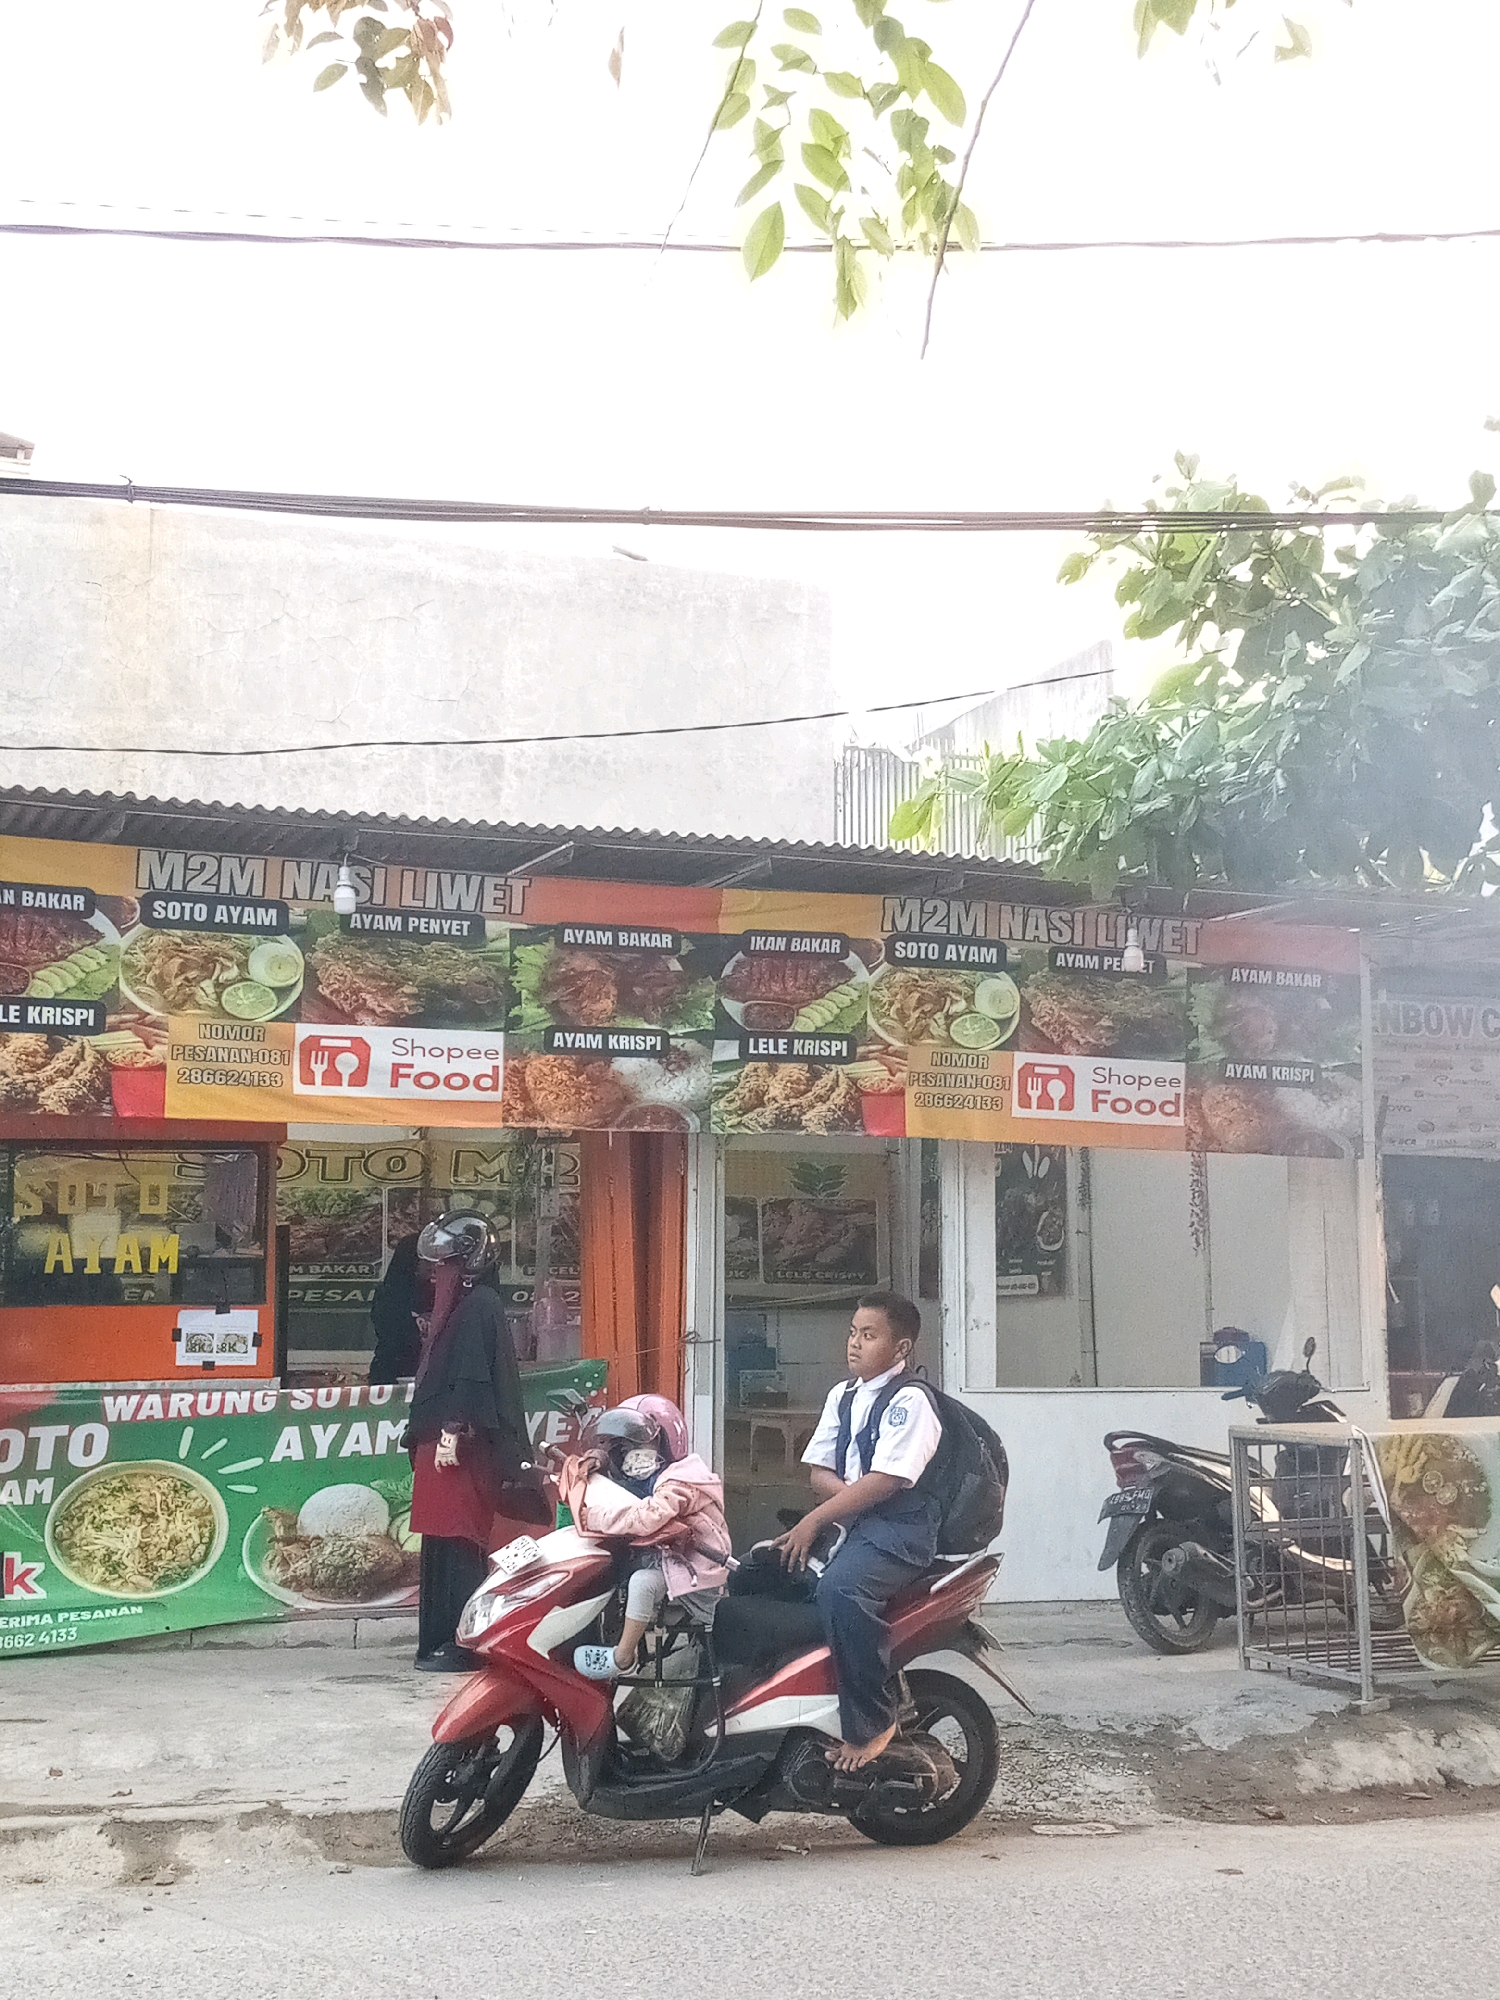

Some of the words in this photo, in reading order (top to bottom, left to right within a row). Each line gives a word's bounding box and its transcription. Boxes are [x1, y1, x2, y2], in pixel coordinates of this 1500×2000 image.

[136, 848, 267, 898] M2M
[280, 858, 388, 906] NASI
[400, 867, 532, 916] LIWET
[22, 889, 86, 912] BAKAR
[152, 900, 208, 923] SOTO
[214, 904, 278, 926] AYAM
[349, 913, 402, 932] AYAM
[408, 916, 471, 937] PENYET
[881, 896, 988, 938] M2M
[999, 903, 1084, 946] NASI
[1096, 912, 1202, 955] LIWET
[563, 928, 613, 946] AYAM
[618, 931, 673, 949] BAKAR
[750, 936, 787, 952] IKAN
[790, 937, 842, 954] BAKAR
[894, 941, 939, 959] SOTO
[944, 944, 998, 964] AYAM
[1055, 952, 1099, 970] AYAM
[1230, 968, 1273, 985] AYAM
[1276, 971, 1322, 988] BAKAR
[27, 1005, 95, 1026] KRISPI
[198, 1023, 266, 1042] NOMOR
[553, 1031, 603, 1050] AYAM
[608, 1033, 662, 1051] KRISPI
[391, 1037, 500, 1064] Shopee
[748, 1037, 788, 1055] LELE
[793, 1039, 848, 1058] KRISPI
[931, 1051, 989, 1070] NOMOR
[177, 1067, 283, 1088] 286624133
[390, 1062, 500, 1093] Food
[1091, 1066, 1182, 1091] Shopee
[1224, 1063, 1268, 1081] AYAM
[1271, 1066, 1316, 1084] KRISPI
[914, 1092, 1004, 1112] 286624133
[1090, 1089, 1181, 1118] Food
[13, 1174, 169, 1217] SOTO
[44, 1233, 180, 1274] AYAM
[309, 1264, 370, 1274] BAKAR
[103, 1389, 278, 1423] WARUNG
[0, 1422, 110, 1474] OTO
[269, 1418, 409, 1463] AYAM
[0, 1476, 55, 1505] AM
[57, 1606, 143, 1623] PESANAN
[0, 1633, 35, 1649] 662
[38, 1626, 78, 1644] 4133
